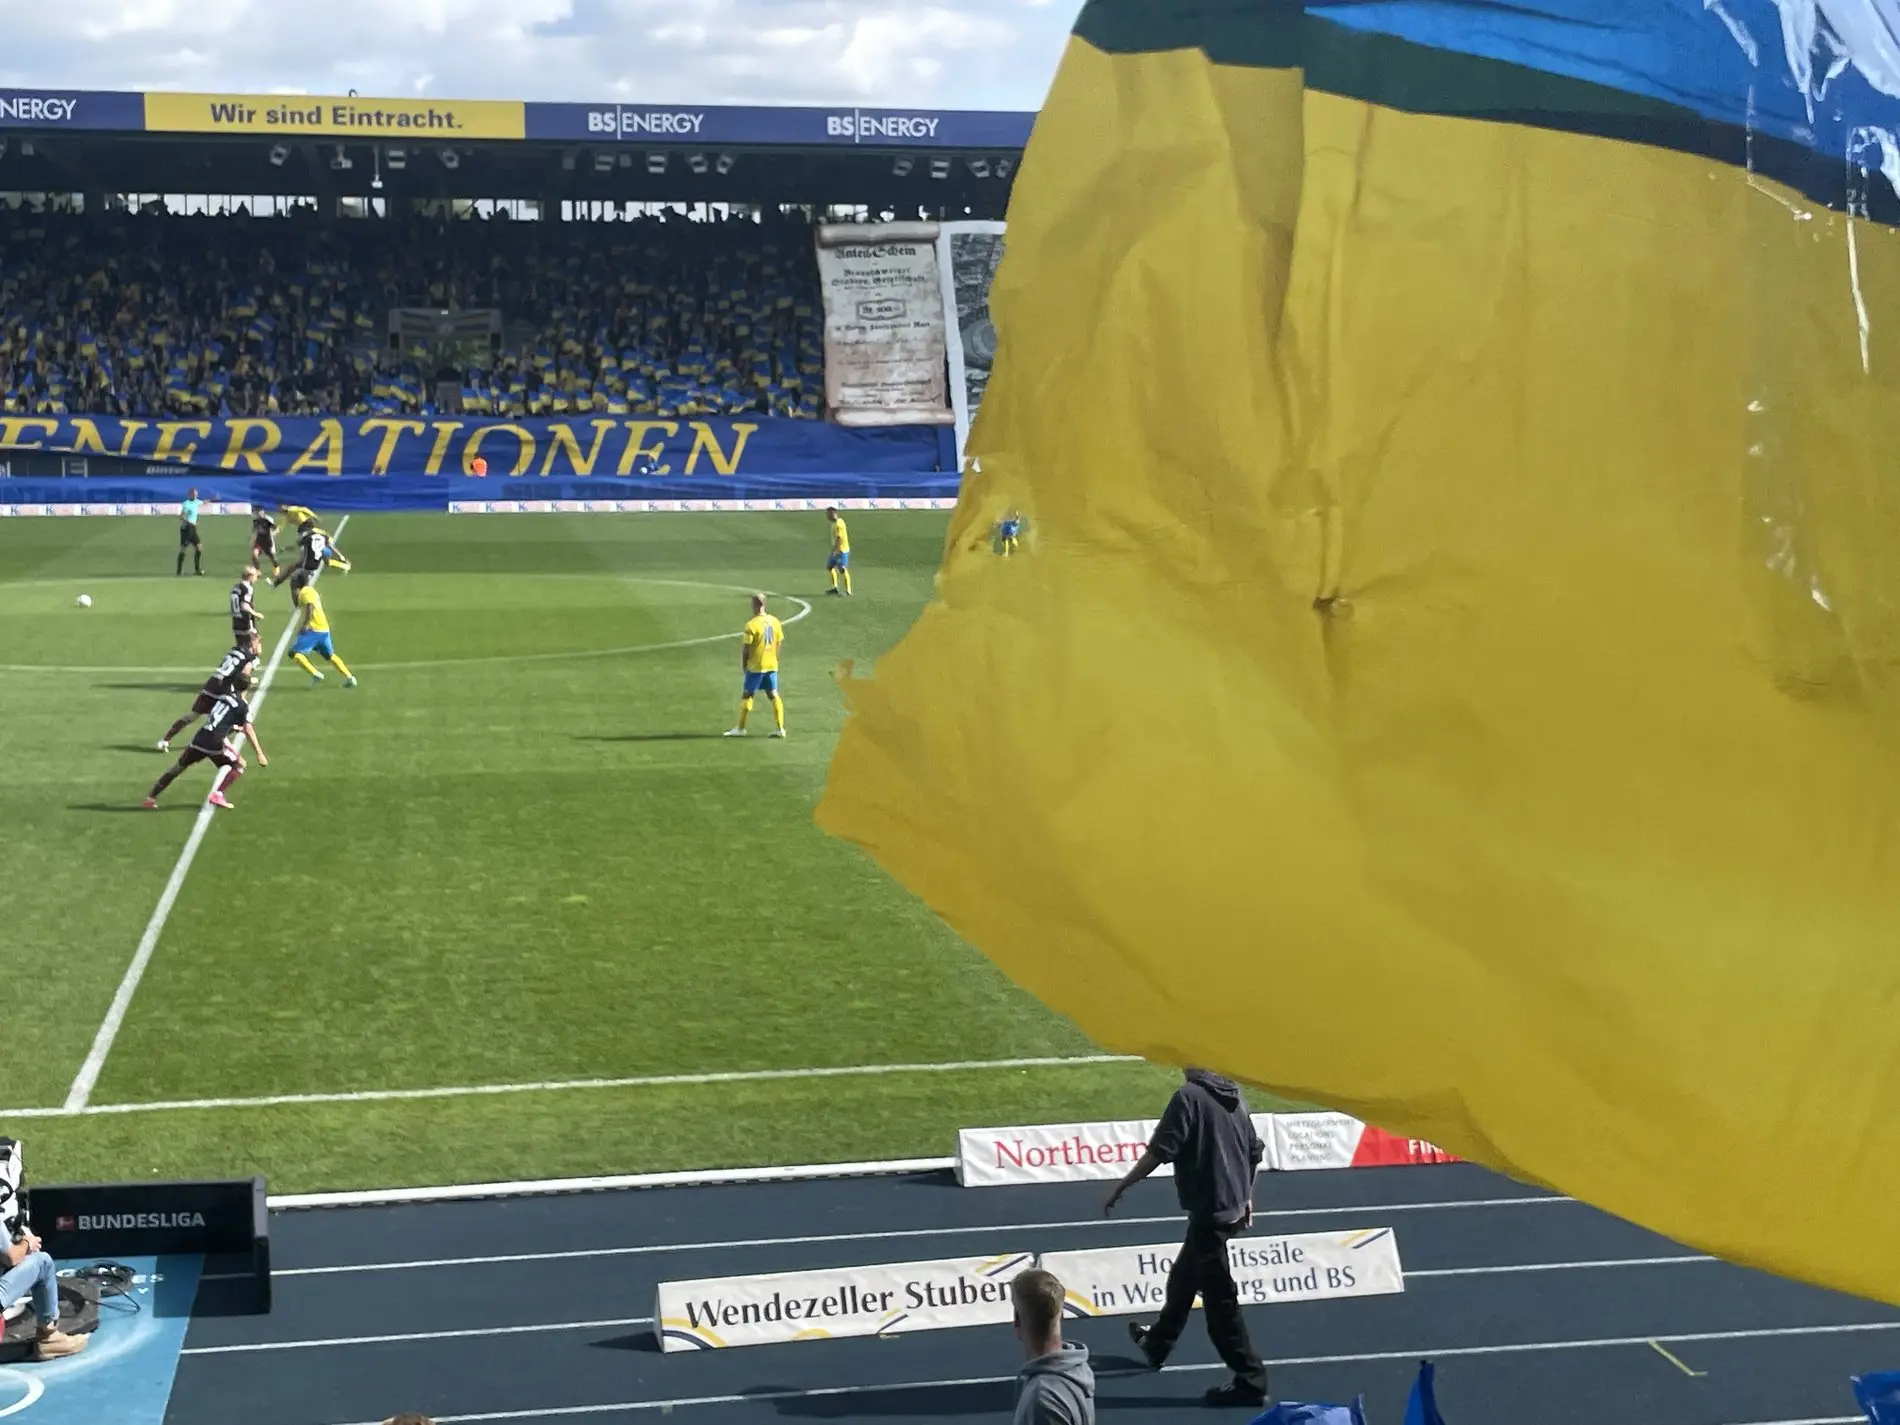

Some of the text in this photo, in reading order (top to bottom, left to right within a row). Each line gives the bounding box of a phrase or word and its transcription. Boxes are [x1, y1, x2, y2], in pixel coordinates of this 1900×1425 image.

[0, 98, 77, 121] NERGY
[210, 102, 465, 131] Wir sind Eintracht.
[993, 1135, 1149, 1169] Northern
[1289, 1141, 1332, 1151] PERSONAL
[78, 1212, 206, 1231] BUNDESLIGA
[1092, 1284, 1116, 1308] in
[1273, 1267, 1318, 1293] und
[1327, 1265, 1356, 1289] BS
[685, 1276, 1013, 1331] Wendezeller Stuben
